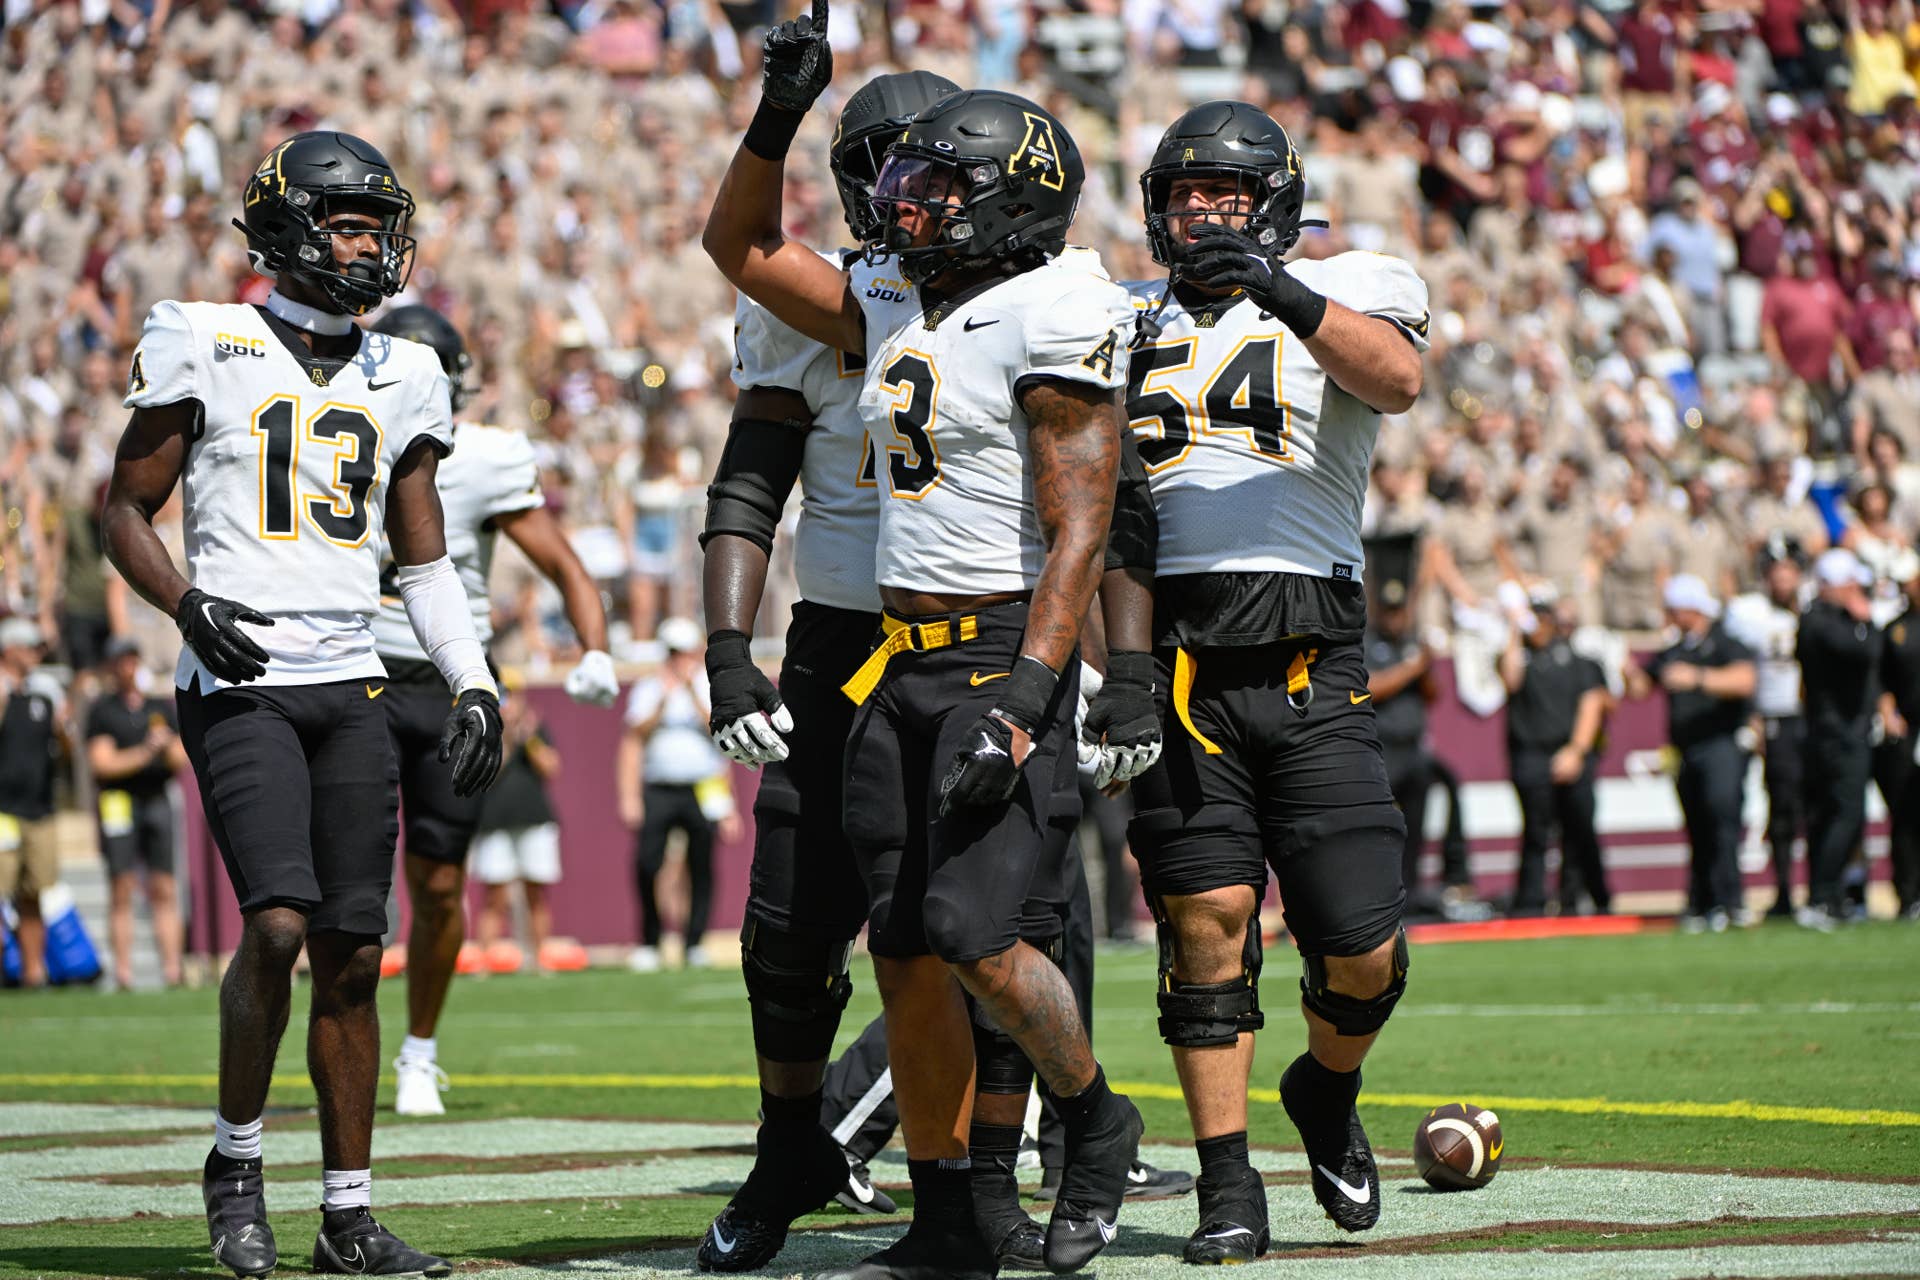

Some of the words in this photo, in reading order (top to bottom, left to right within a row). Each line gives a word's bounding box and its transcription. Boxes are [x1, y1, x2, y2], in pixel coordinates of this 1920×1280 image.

[1008, 112, 1065, 191] A
[867, 277, 912, 303] SBC
[1195, 312, 1215, 328] A
[216, 332, 265, 358] SBC
[1080, 327, 1119, 384] A
[311, 368, 329, 387] A
[1125, 331, 1295, 475] 54
[879, 347, 943, 501] 3
[250, 393, 384, 549] 13
[1335, 566, 1351, 578] 2XL
